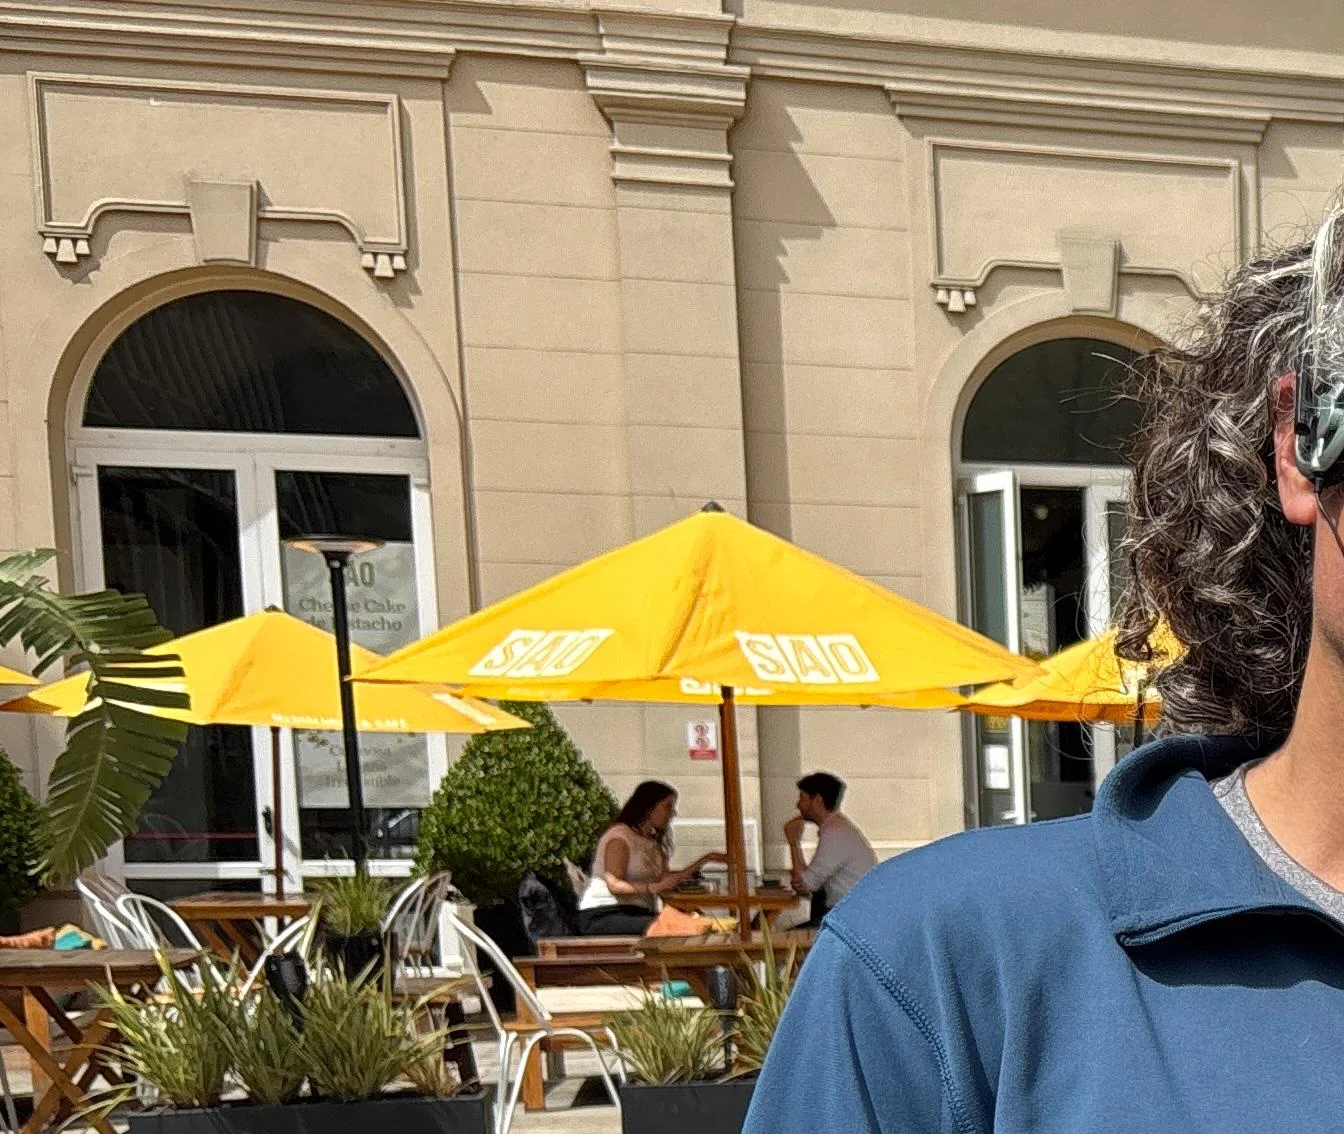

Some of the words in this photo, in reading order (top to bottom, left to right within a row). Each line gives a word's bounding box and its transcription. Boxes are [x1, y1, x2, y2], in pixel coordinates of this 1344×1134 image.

[299, 596, 362, 613] Chee
[364, 598, 407, 614] Cake
[482, 630, 604, 675] SAO
[742, 634, 871, 680] SAO
